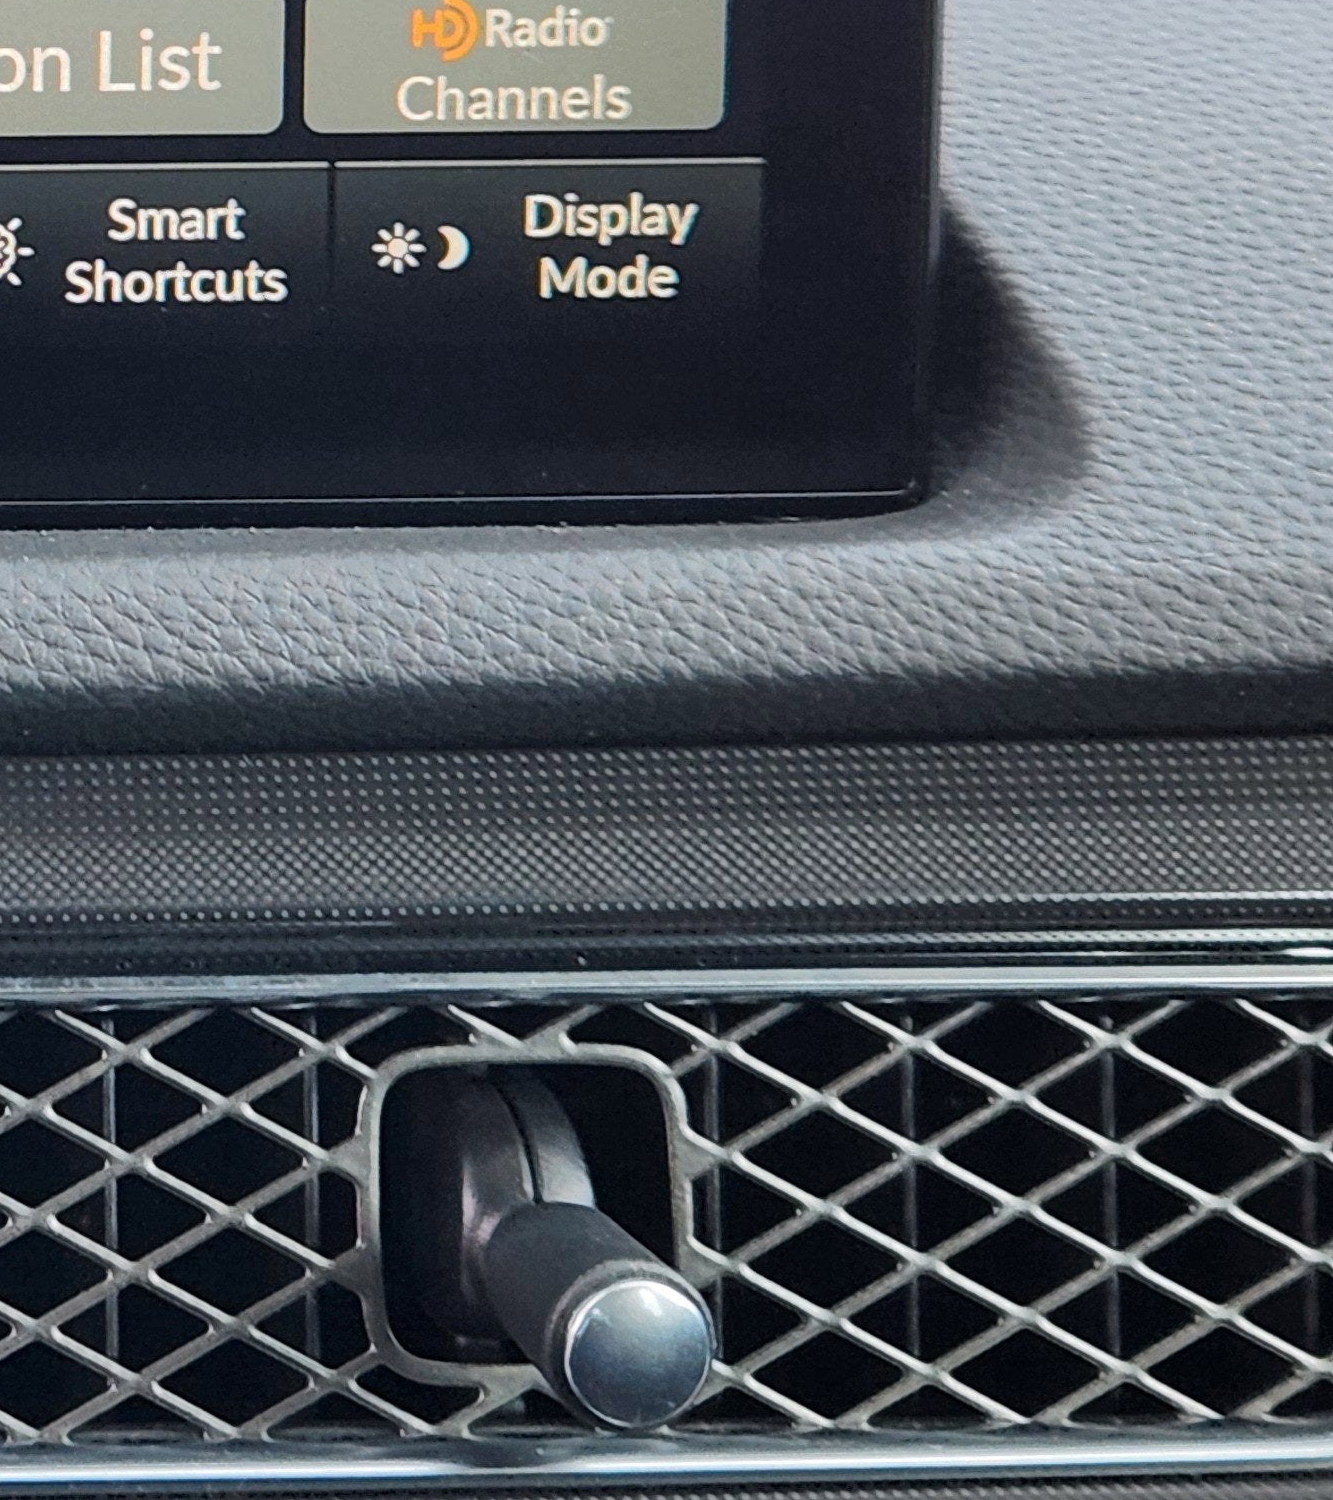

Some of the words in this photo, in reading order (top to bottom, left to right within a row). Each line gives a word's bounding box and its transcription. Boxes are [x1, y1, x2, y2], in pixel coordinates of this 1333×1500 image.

[96, 28, 224, 93] List
[396, 74, 632, 123] Channels
[106, 197, 248, 242] Smart
[523, 191, 700, 246] Display
[64, 259, 290, 305] Shortcuts
[537, 254, 681, 301] Mode
